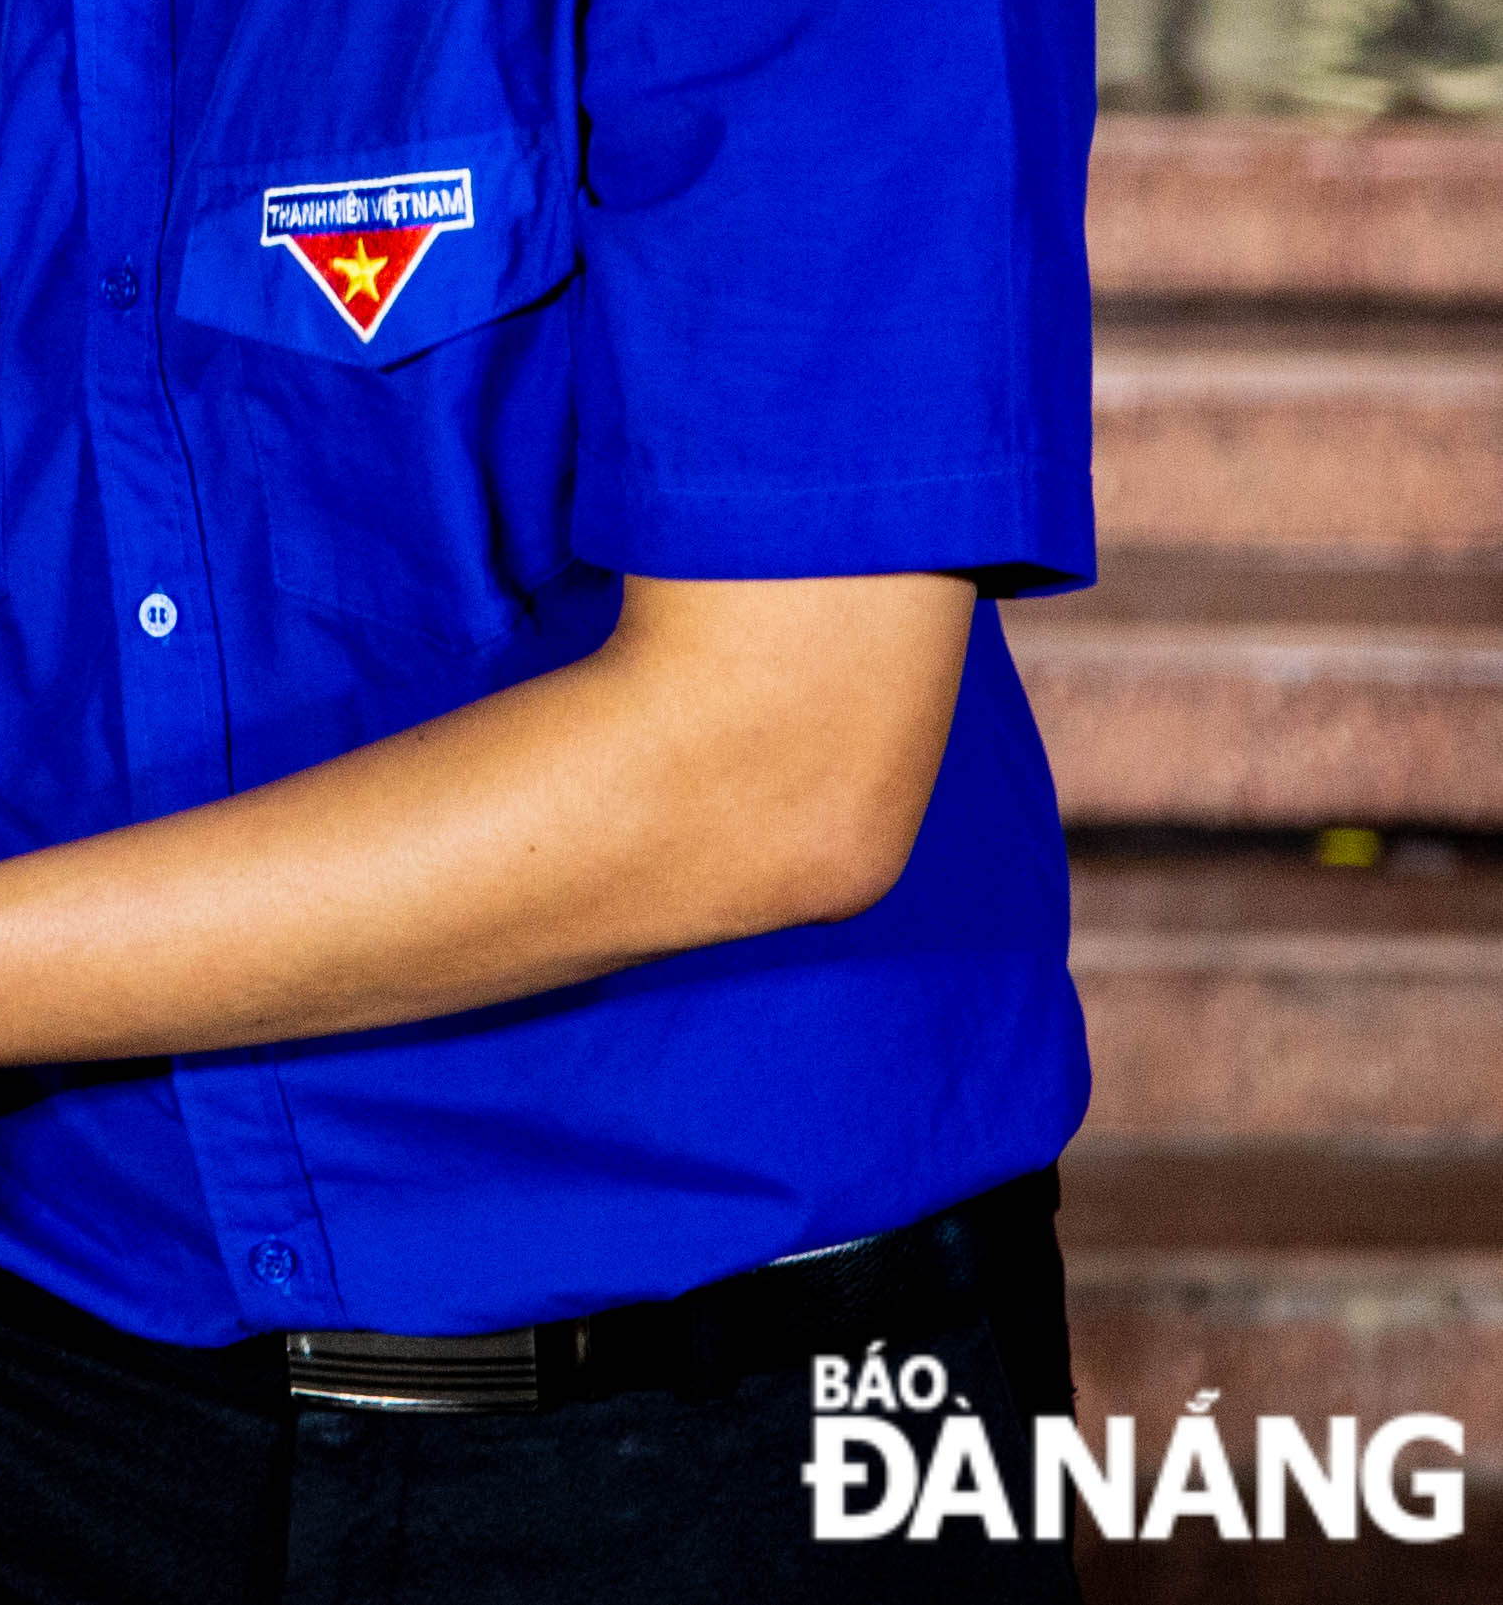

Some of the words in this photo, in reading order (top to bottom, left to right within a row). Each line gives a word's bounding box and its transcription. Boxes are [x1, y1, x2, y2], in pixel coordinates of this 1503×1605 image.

[268, 199, 328, 228] THANH
[371, 187, 411, 227] VIỆT
[412, 187, 464, 219] NAM
